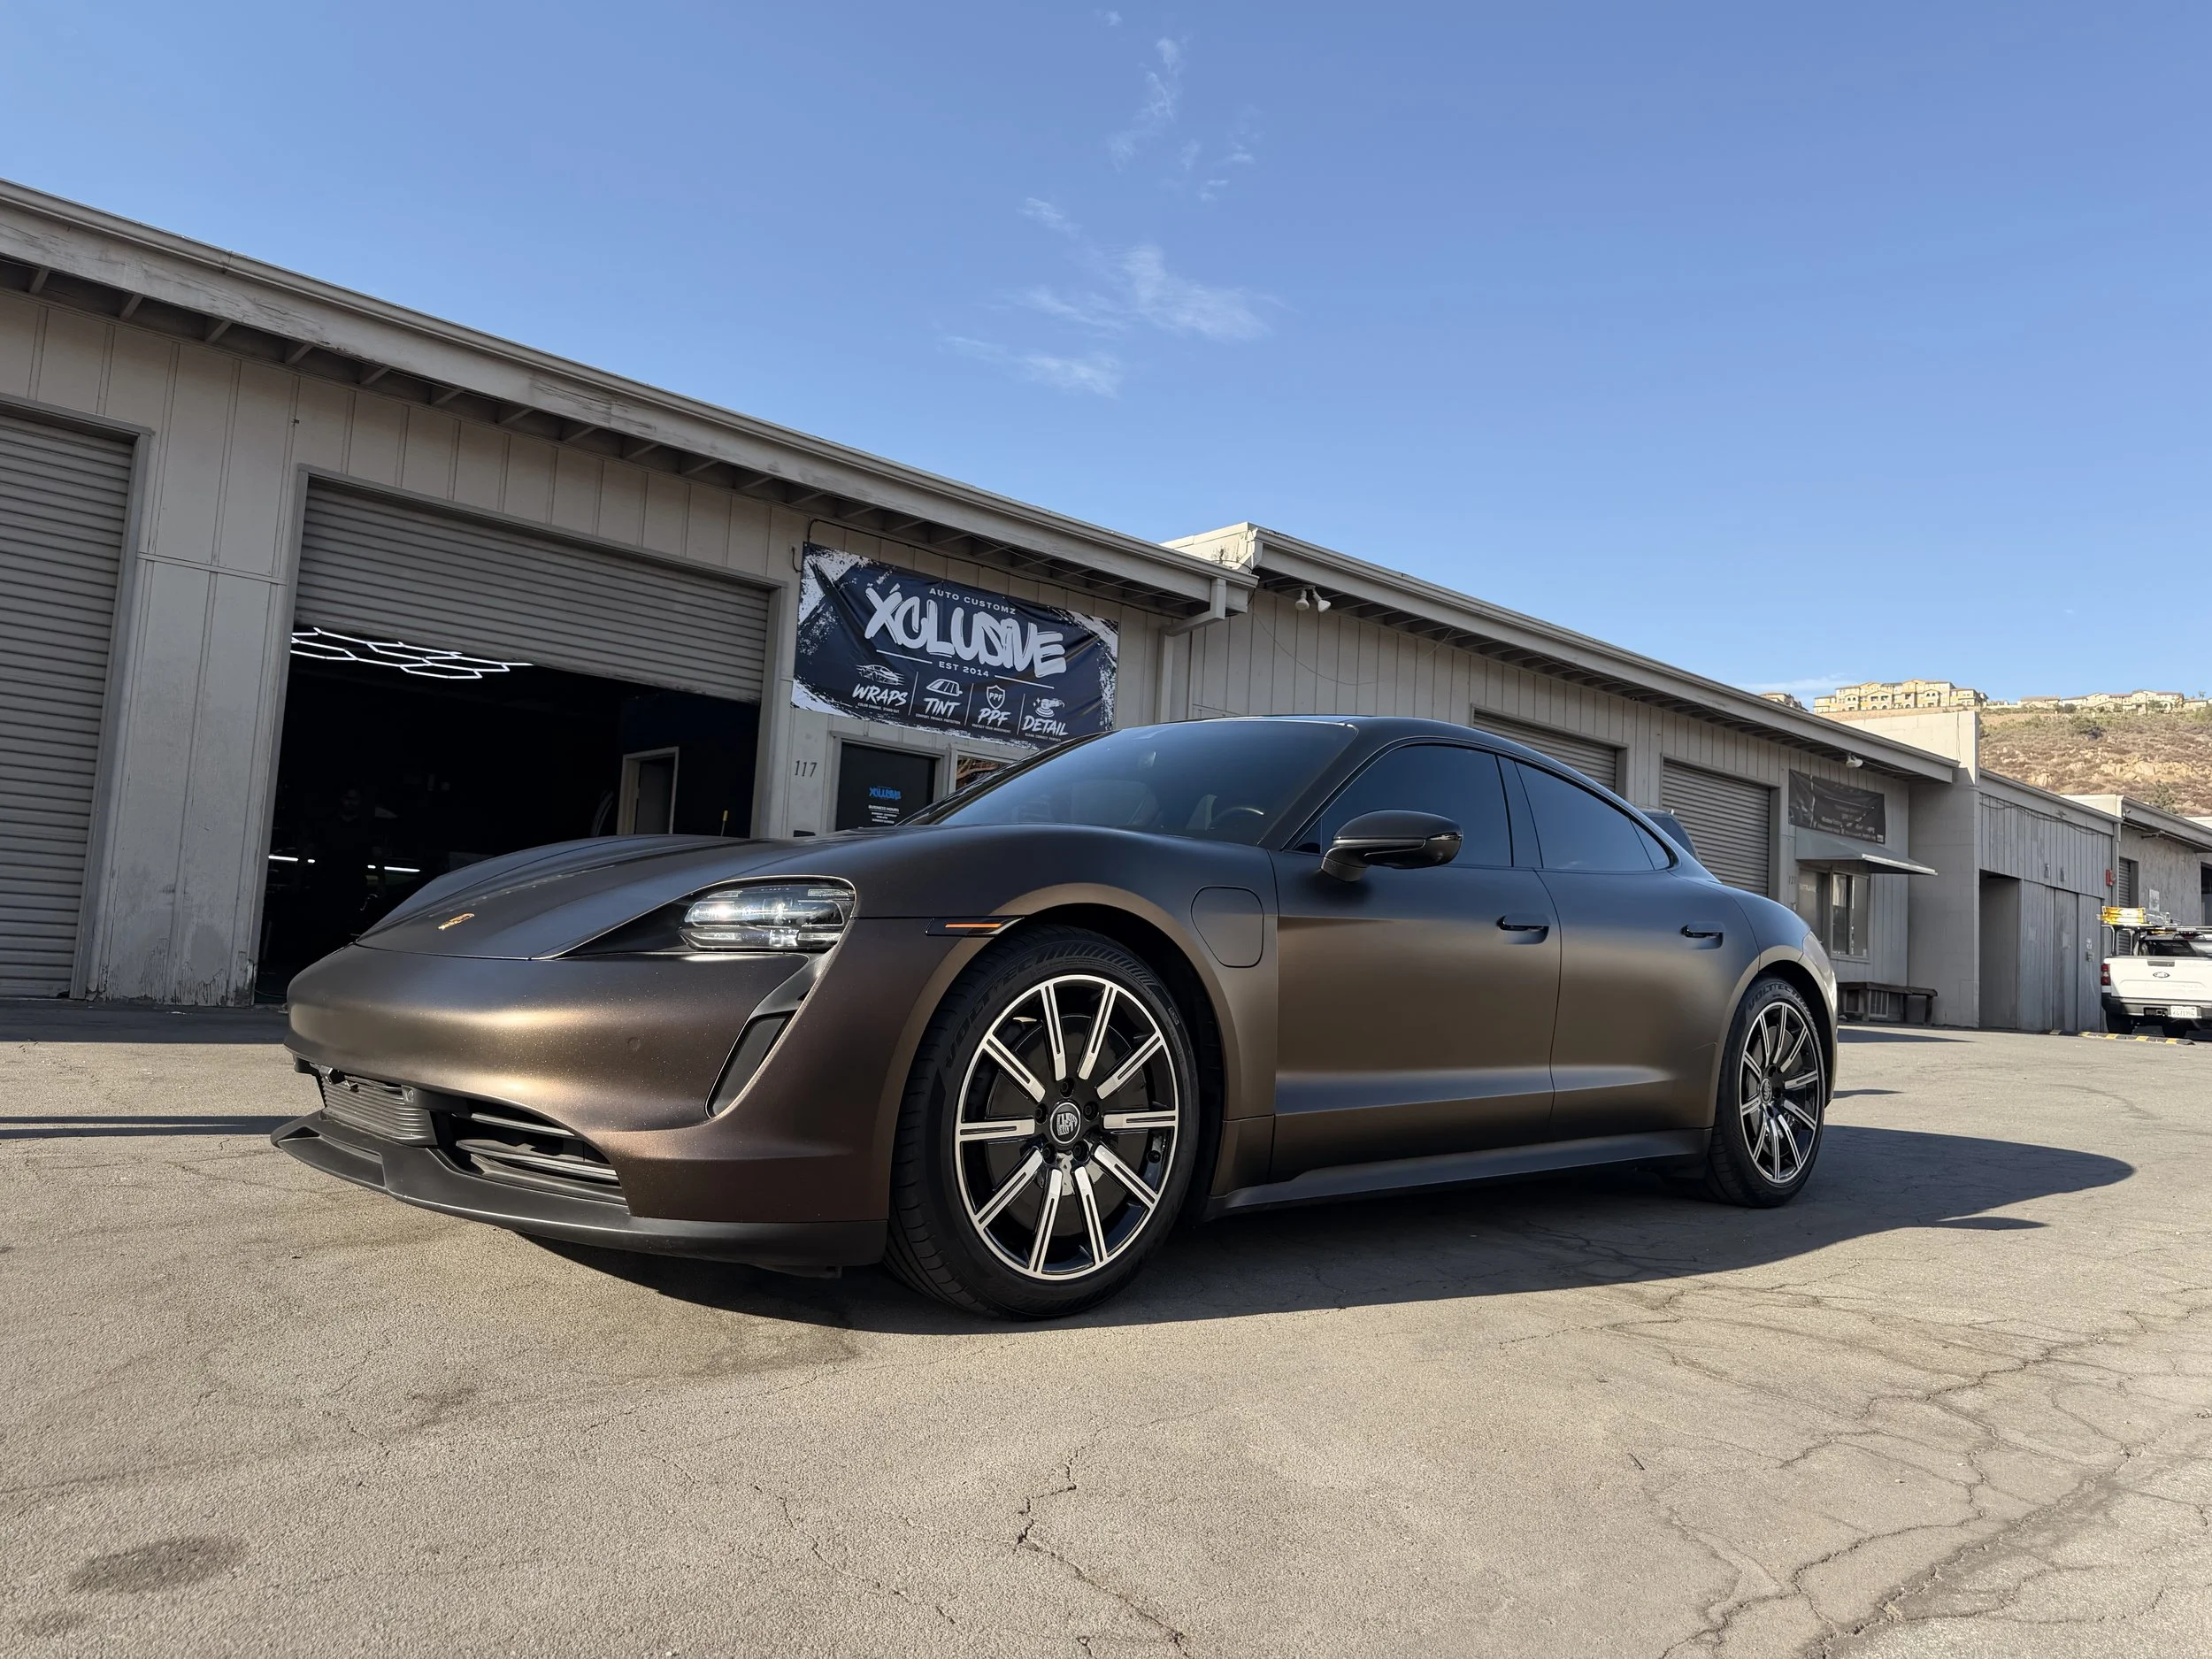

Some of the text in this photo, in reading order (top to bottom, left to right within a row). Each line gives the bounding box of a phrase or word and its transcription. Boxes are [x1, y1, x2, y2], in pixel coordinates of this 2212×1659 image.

[929, 588, 1017, 616] AUTO CUSTOMZ
[864, 585, 1067, 679] XCLUSIVE
[939, 661, 989, 678] EST 2014
[852, 683, 909, 707] WRAPS
[988, 692, 1003, 702] PPF
[923, 697, 962, 718] TINT
[977, 708, 1011, 727] PPF
[1021, 715, 1069, 736] DETAIL
[795, 760, 818, 778] 117
